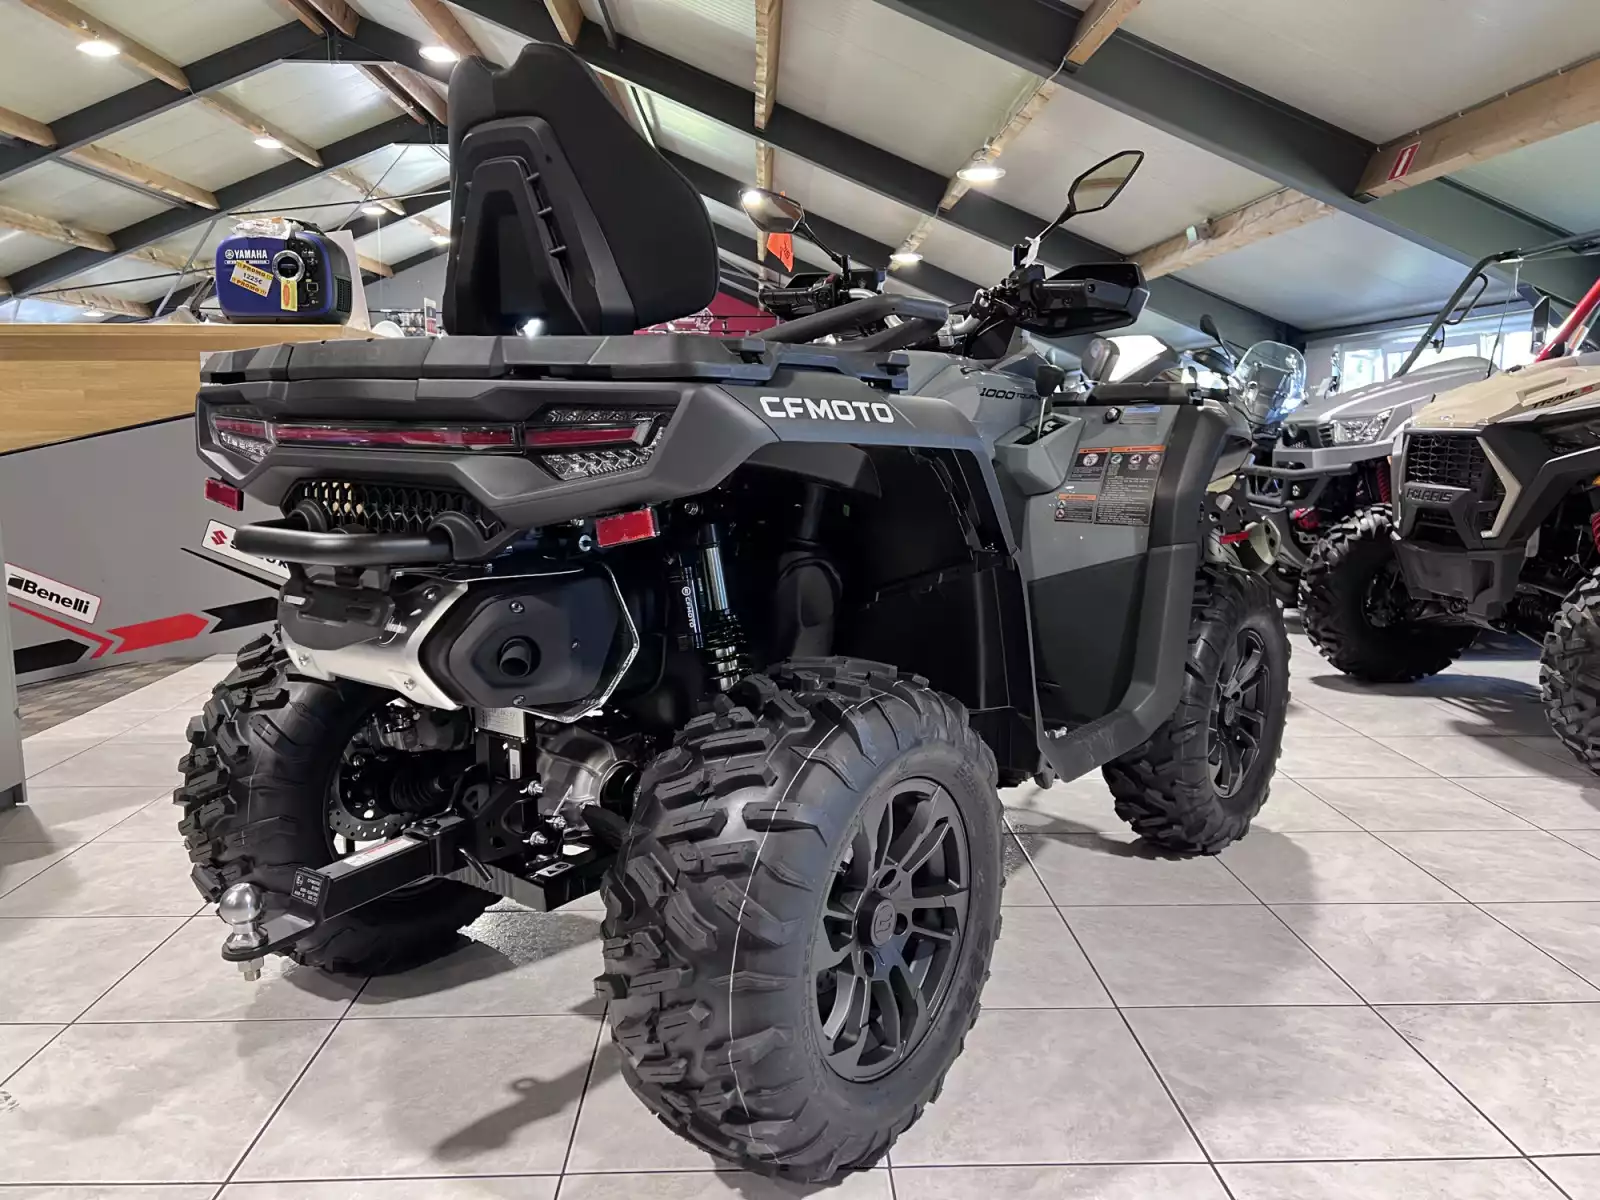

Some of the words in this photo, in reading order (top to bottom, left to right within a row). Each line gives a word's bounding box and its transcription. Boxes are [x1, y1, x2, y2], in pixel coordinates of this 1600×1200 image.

[234, 249, 268, 259] YAMAHA
[243, 264, 266, 277] PROMO
[236, 279, 260, 293] PROMO
[979, 387, 1016, 400] 1000
[1533, 391, 1578, 408] TRAIL
[759, 396, 895, 424] CFMOTO
[1406, 487, 1453, 503] POLARIS
[22, 579, 91, 615] Benelli
[685, 596, 695, 628] CFMOTO
